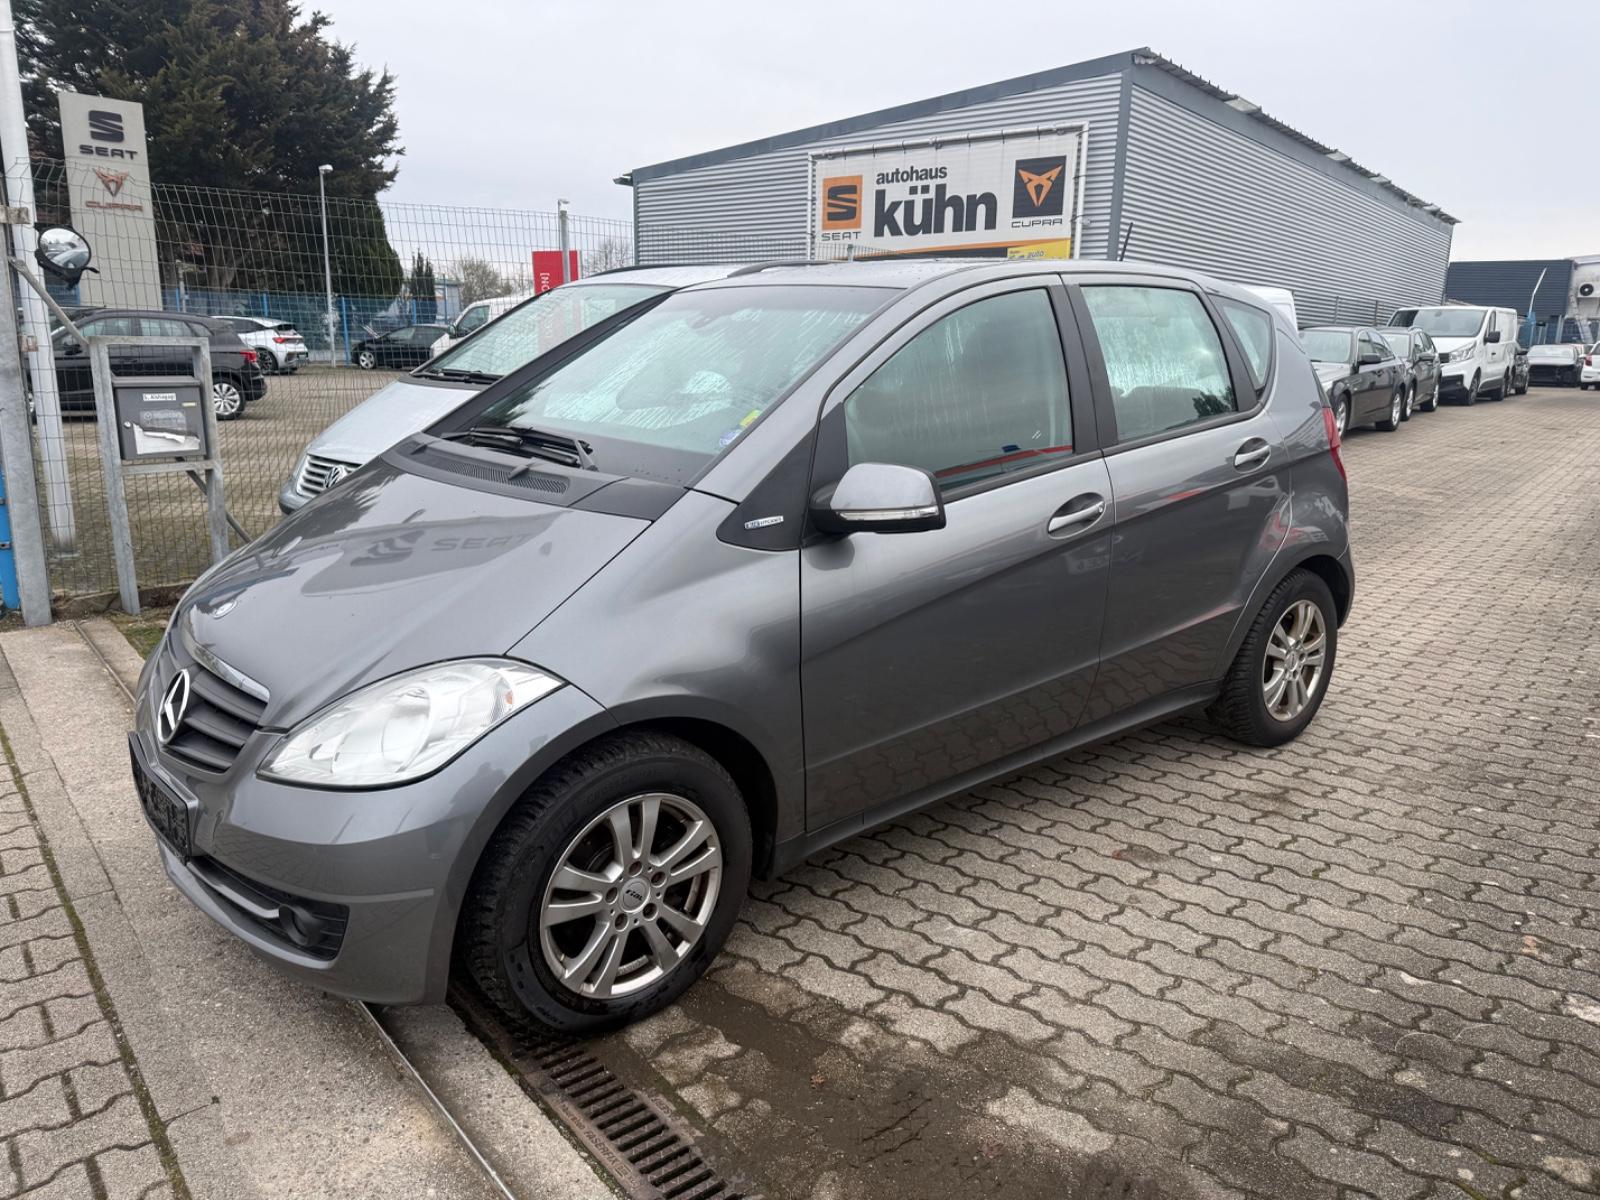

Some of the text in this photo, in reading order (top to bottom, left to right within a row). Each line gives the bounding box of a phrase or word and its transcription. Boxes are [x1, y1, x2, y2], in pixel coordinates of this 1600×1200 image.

[79, 144, 138, 159] SEAT
[876, 166, 948, 184] autohaus
[874, 183, 998, 238] kühn
[1011, 217, 1063, 229] CUPRA
[821, 231, 861, 242] SEAT
